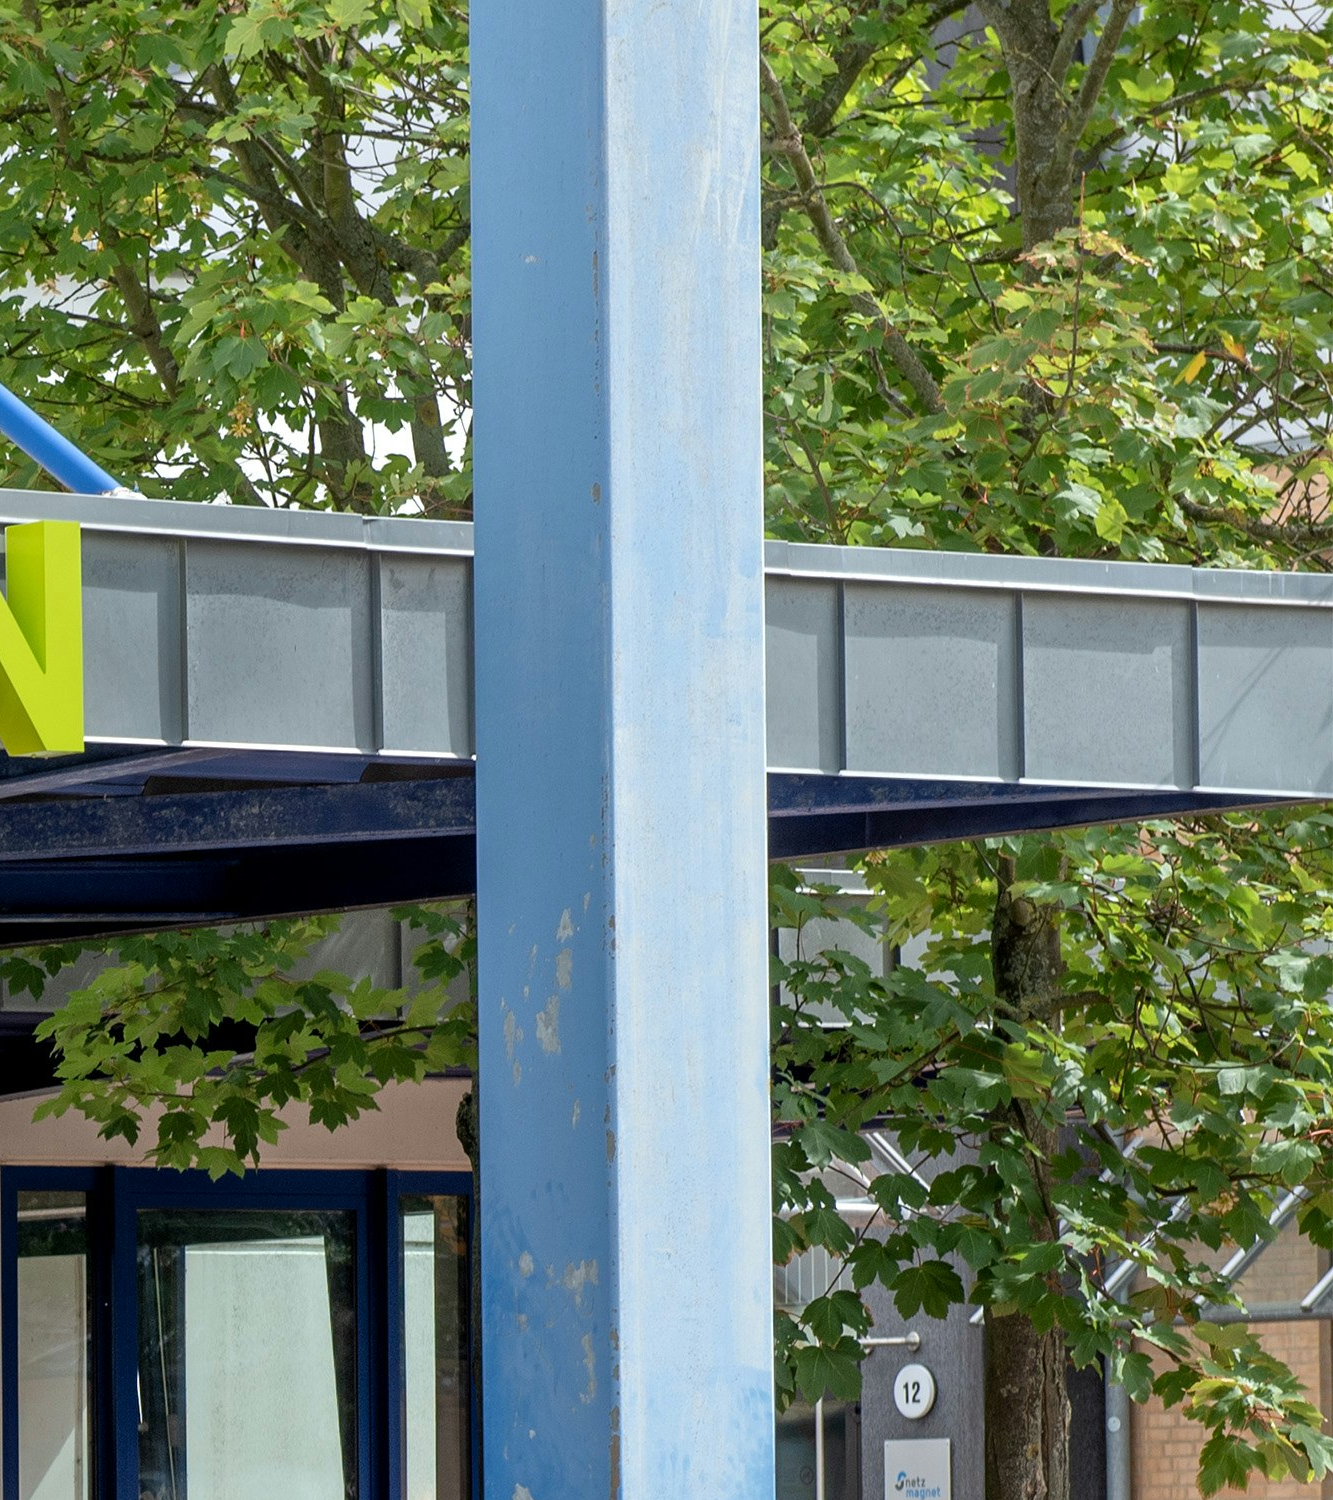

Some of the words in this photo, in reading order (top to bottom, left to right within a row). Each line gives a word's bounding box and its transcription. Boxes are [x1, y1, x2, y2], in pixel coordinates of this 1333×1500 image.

[902, 1381, 921, 1404] 12
[905, 1477, 926, 1487] netz
[906, 1488, 941, 1500] magnet
